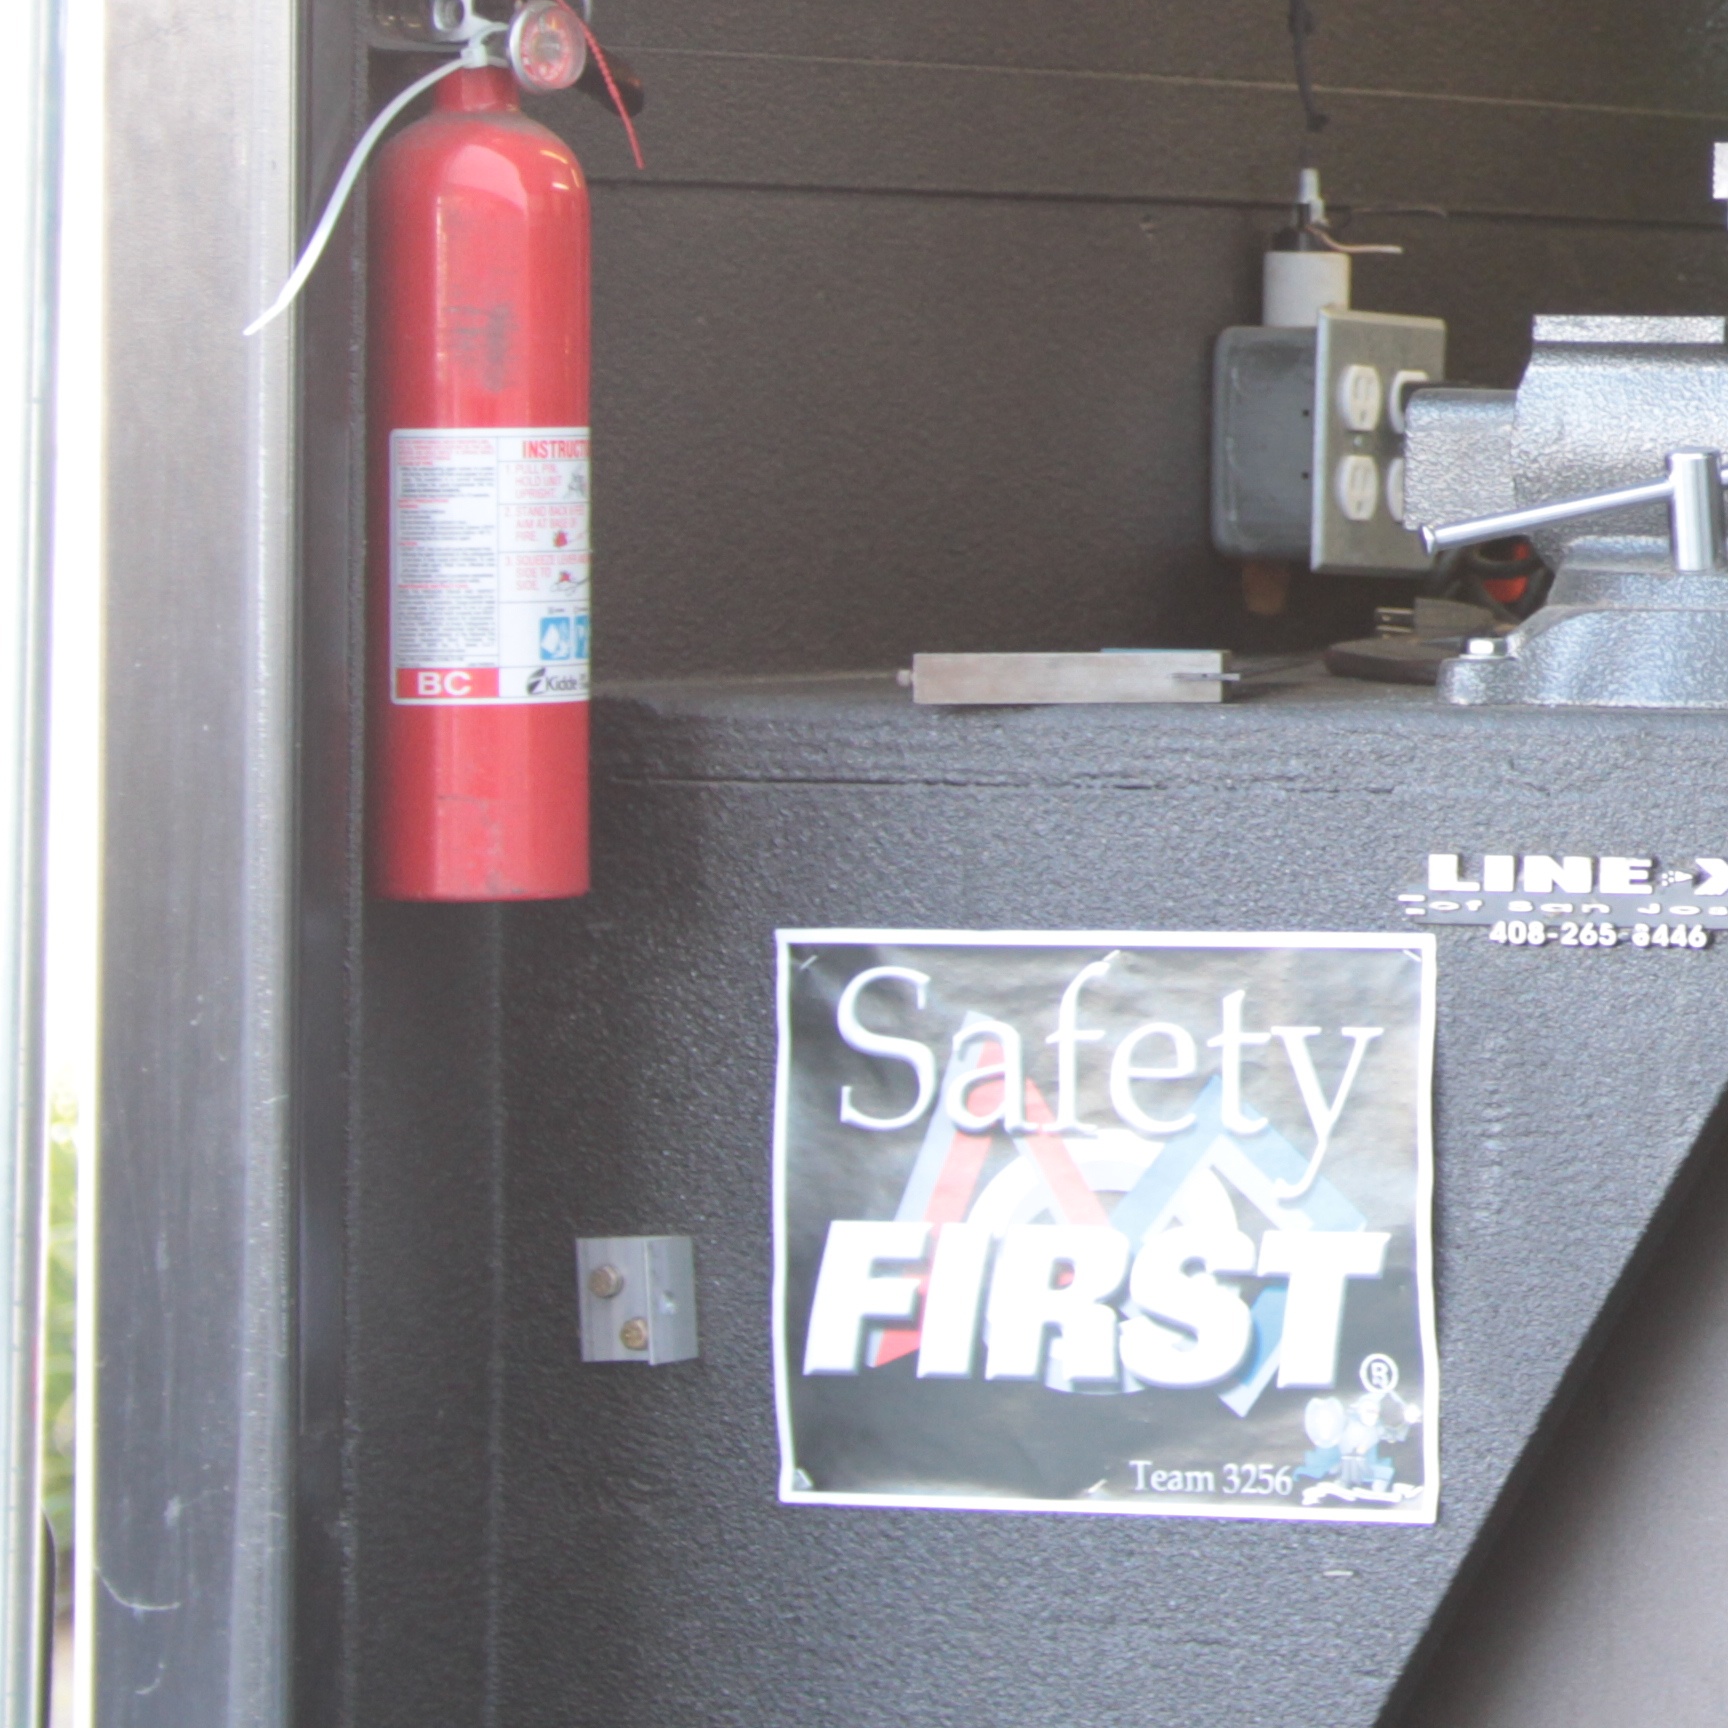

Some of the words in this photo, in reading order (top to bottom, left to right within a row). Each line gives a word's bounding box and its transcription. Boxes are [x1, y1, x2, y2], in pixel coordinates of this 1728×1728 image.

[417, 671, 472, 696] BC
[1489, 919, 1708, 949] 408-265-8446
[836, 961, 1384, 1200] Safety
[803, 1219, 1392, 1391] FIRST
[1128, 1460, 1215, 1492] Team
[1222, 1463, 1293, 1496] 3256
